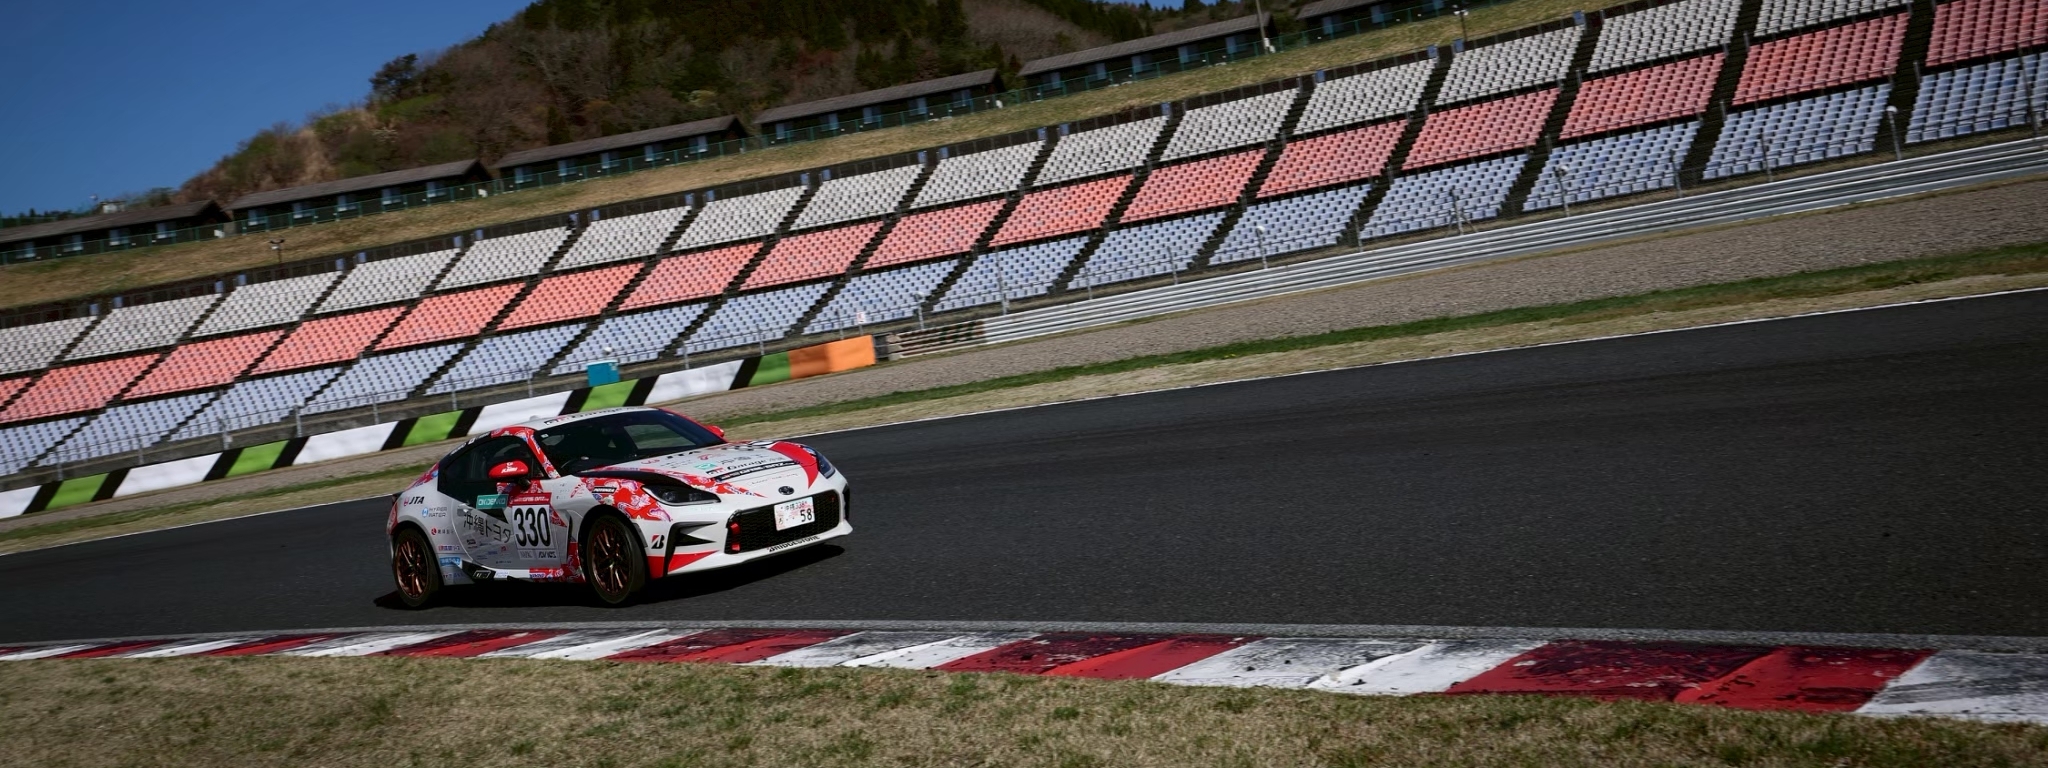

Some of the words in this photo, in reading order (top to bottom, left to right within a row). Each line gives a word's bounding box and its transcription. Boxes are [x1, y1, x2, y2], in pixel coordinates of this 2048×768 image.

[409, 496, 425, 505] JTA
[800, 508, 813, 522] 58
[513, 507, 551, 547] 330
